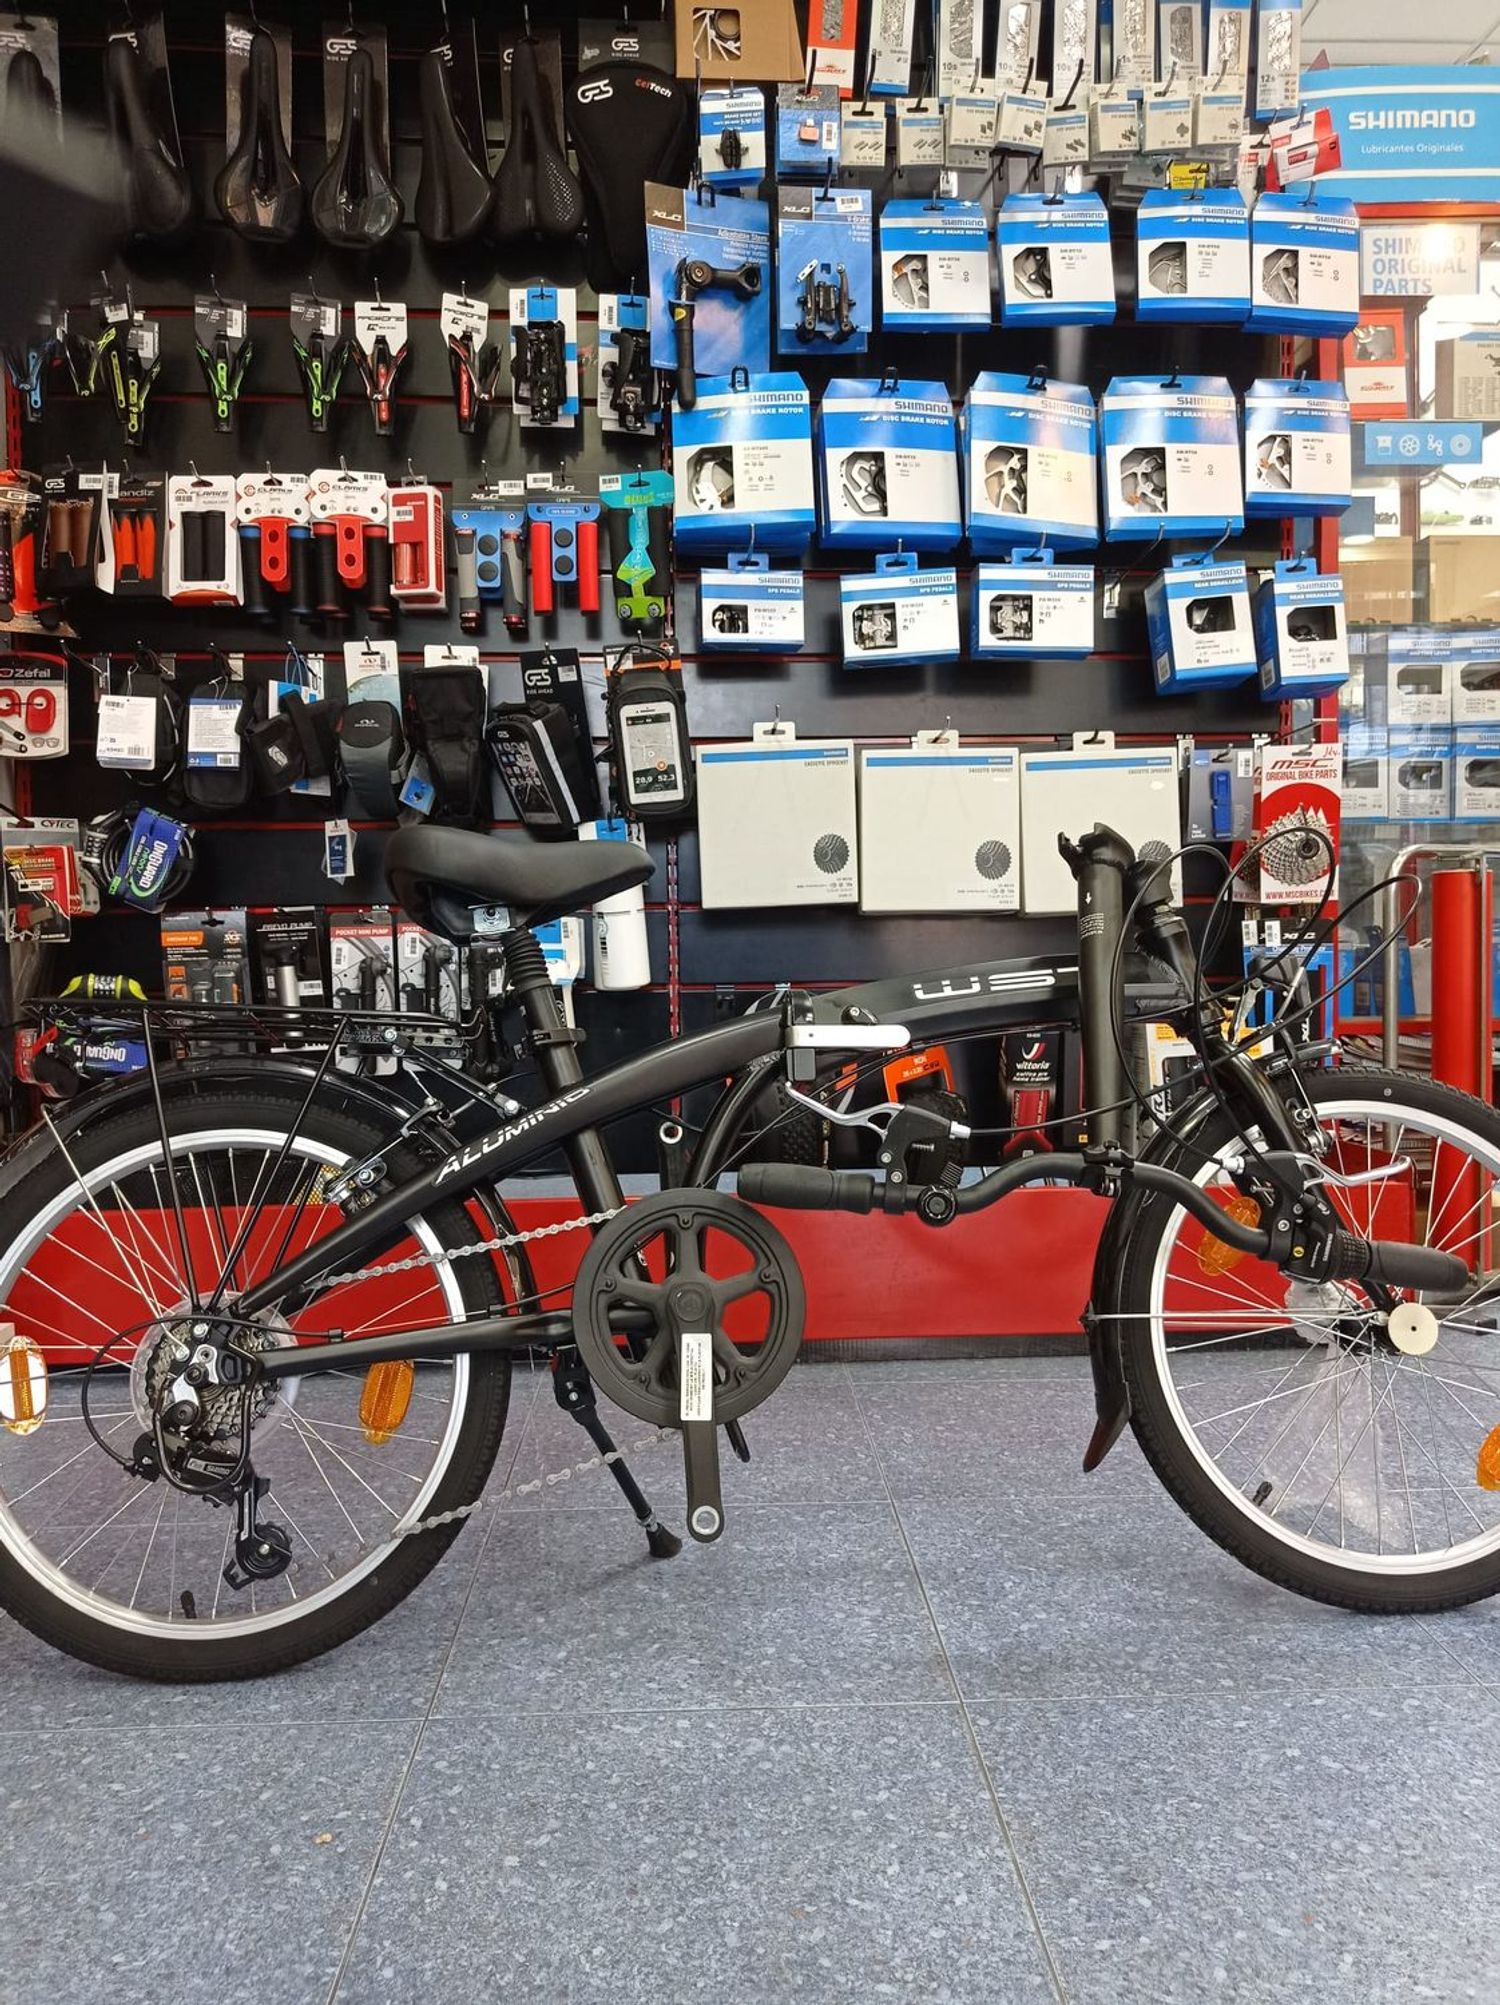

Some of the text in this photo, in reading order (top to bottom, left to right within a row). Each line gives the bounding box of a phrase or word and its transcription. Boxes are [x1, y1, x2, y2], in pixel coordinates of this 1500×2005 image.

[611, 38, 639, 50] GES
[577, 79, 613, 103] GES
[1348, 109, 1476, 130] SHIMANO
[1361, 142, 1464, 154] Lubricantes Originales
[1201, 207, 1245, 216] SHIMANO
[941, 219, 984, 227] SHIMANO
[1314, 215, 1356, 226] SHIMANO
[1373, 278, 1433, 294] PARTS
[894, 400, 948, 412] SHIMANO
[1040, 400, 1092, 416] SHIMANO
[902, 416, 924, 424] BRAKE
[45, 478, 66, 489] GES
[1047, 572, 1090, 580] SHIMANO
[1200, 568, 1243, 578] SHIMANO
[758, 577, 800, 585] SHIMANO
[909, 575, 952, 586] SHIMANO
[1296, 582, 1340, 592] SHIMANO
[525, 669, 552, 686] GES
[1266, 768, 1338, 781] ORIGINAL BIKE PARTS
[140, 840, 168, 889] ONGUARD
[1265, 890, 1335, 900] WWW.MSCBIKES.CM
